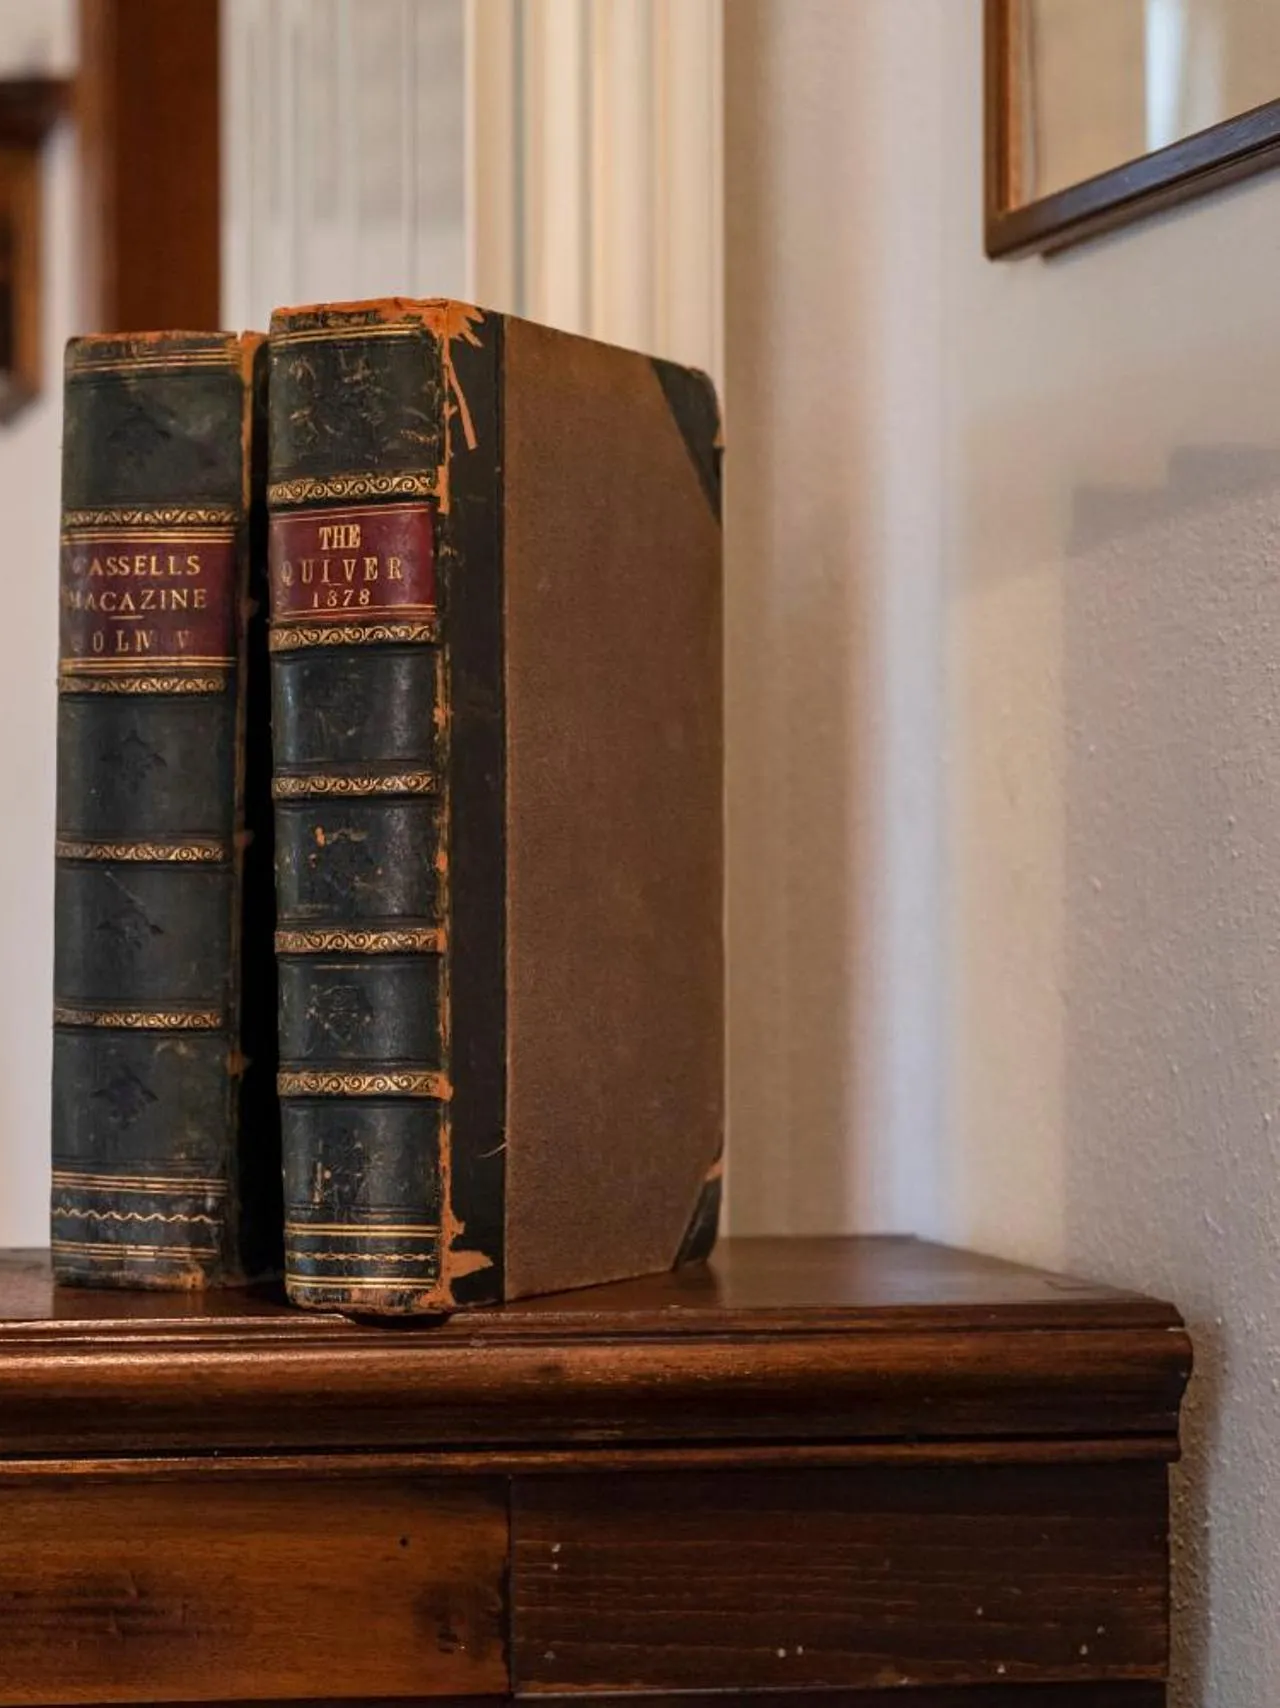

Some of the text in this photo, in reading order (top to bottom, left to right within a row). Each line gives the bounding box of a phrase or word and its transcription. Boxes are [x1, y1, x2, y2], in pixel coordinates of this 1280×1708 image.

[318, 523, 362, 551] THE
[280, 555, 404, 587] QUIVER
[312, 587, 371, 609] 1878
